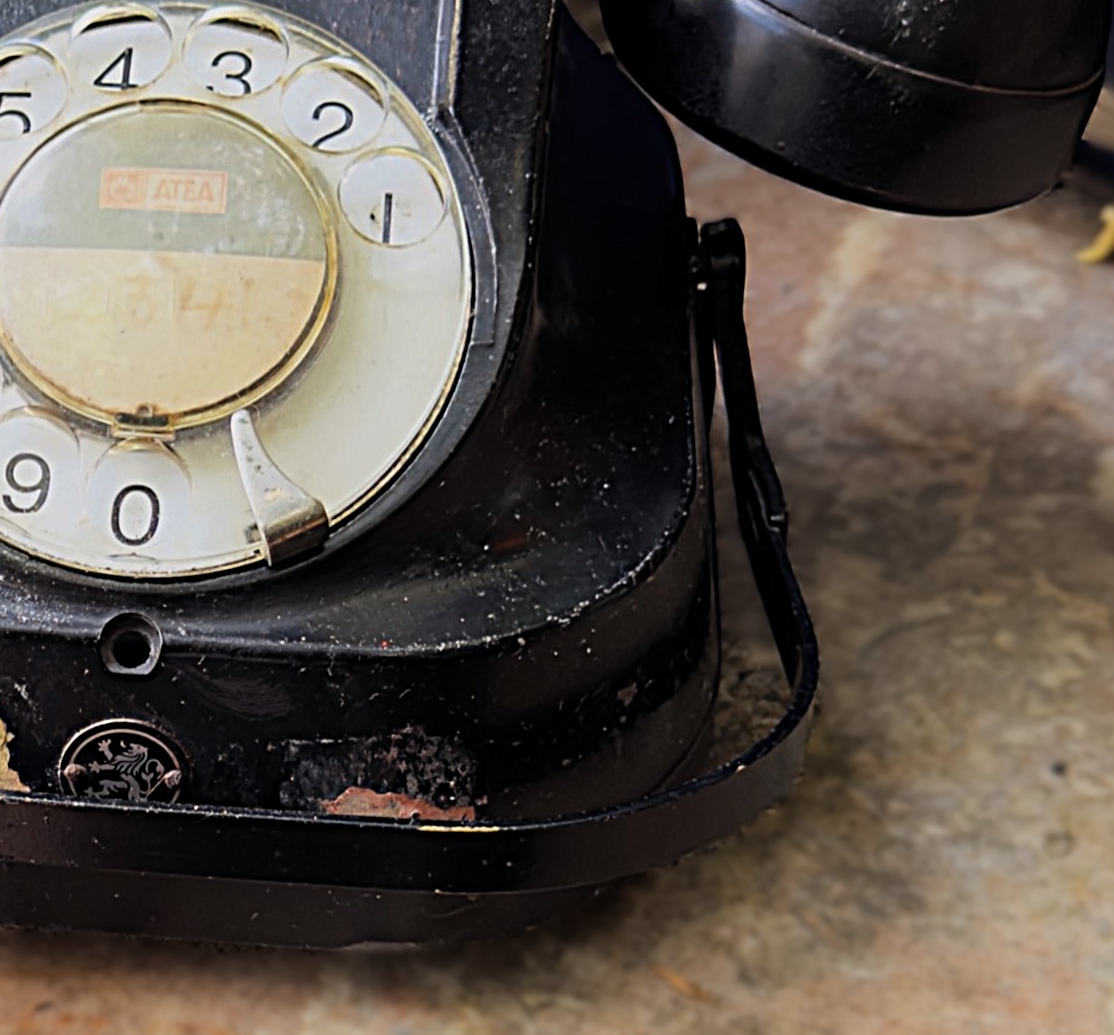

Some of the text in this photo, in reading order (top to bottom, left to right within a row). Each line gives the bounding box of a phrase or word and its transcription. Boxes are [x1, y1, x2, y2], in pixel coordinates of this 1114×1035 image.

[94, 48, 138, 90] 4
[207, 51, 252, 94] 3
[311, 102, 353, 148] 2
[152, 178, 215, 203] ATEA
[382, 192, 393, 244] 1
[3, 454, 51, 514] 9
[112, 485, 160, 546] 0
